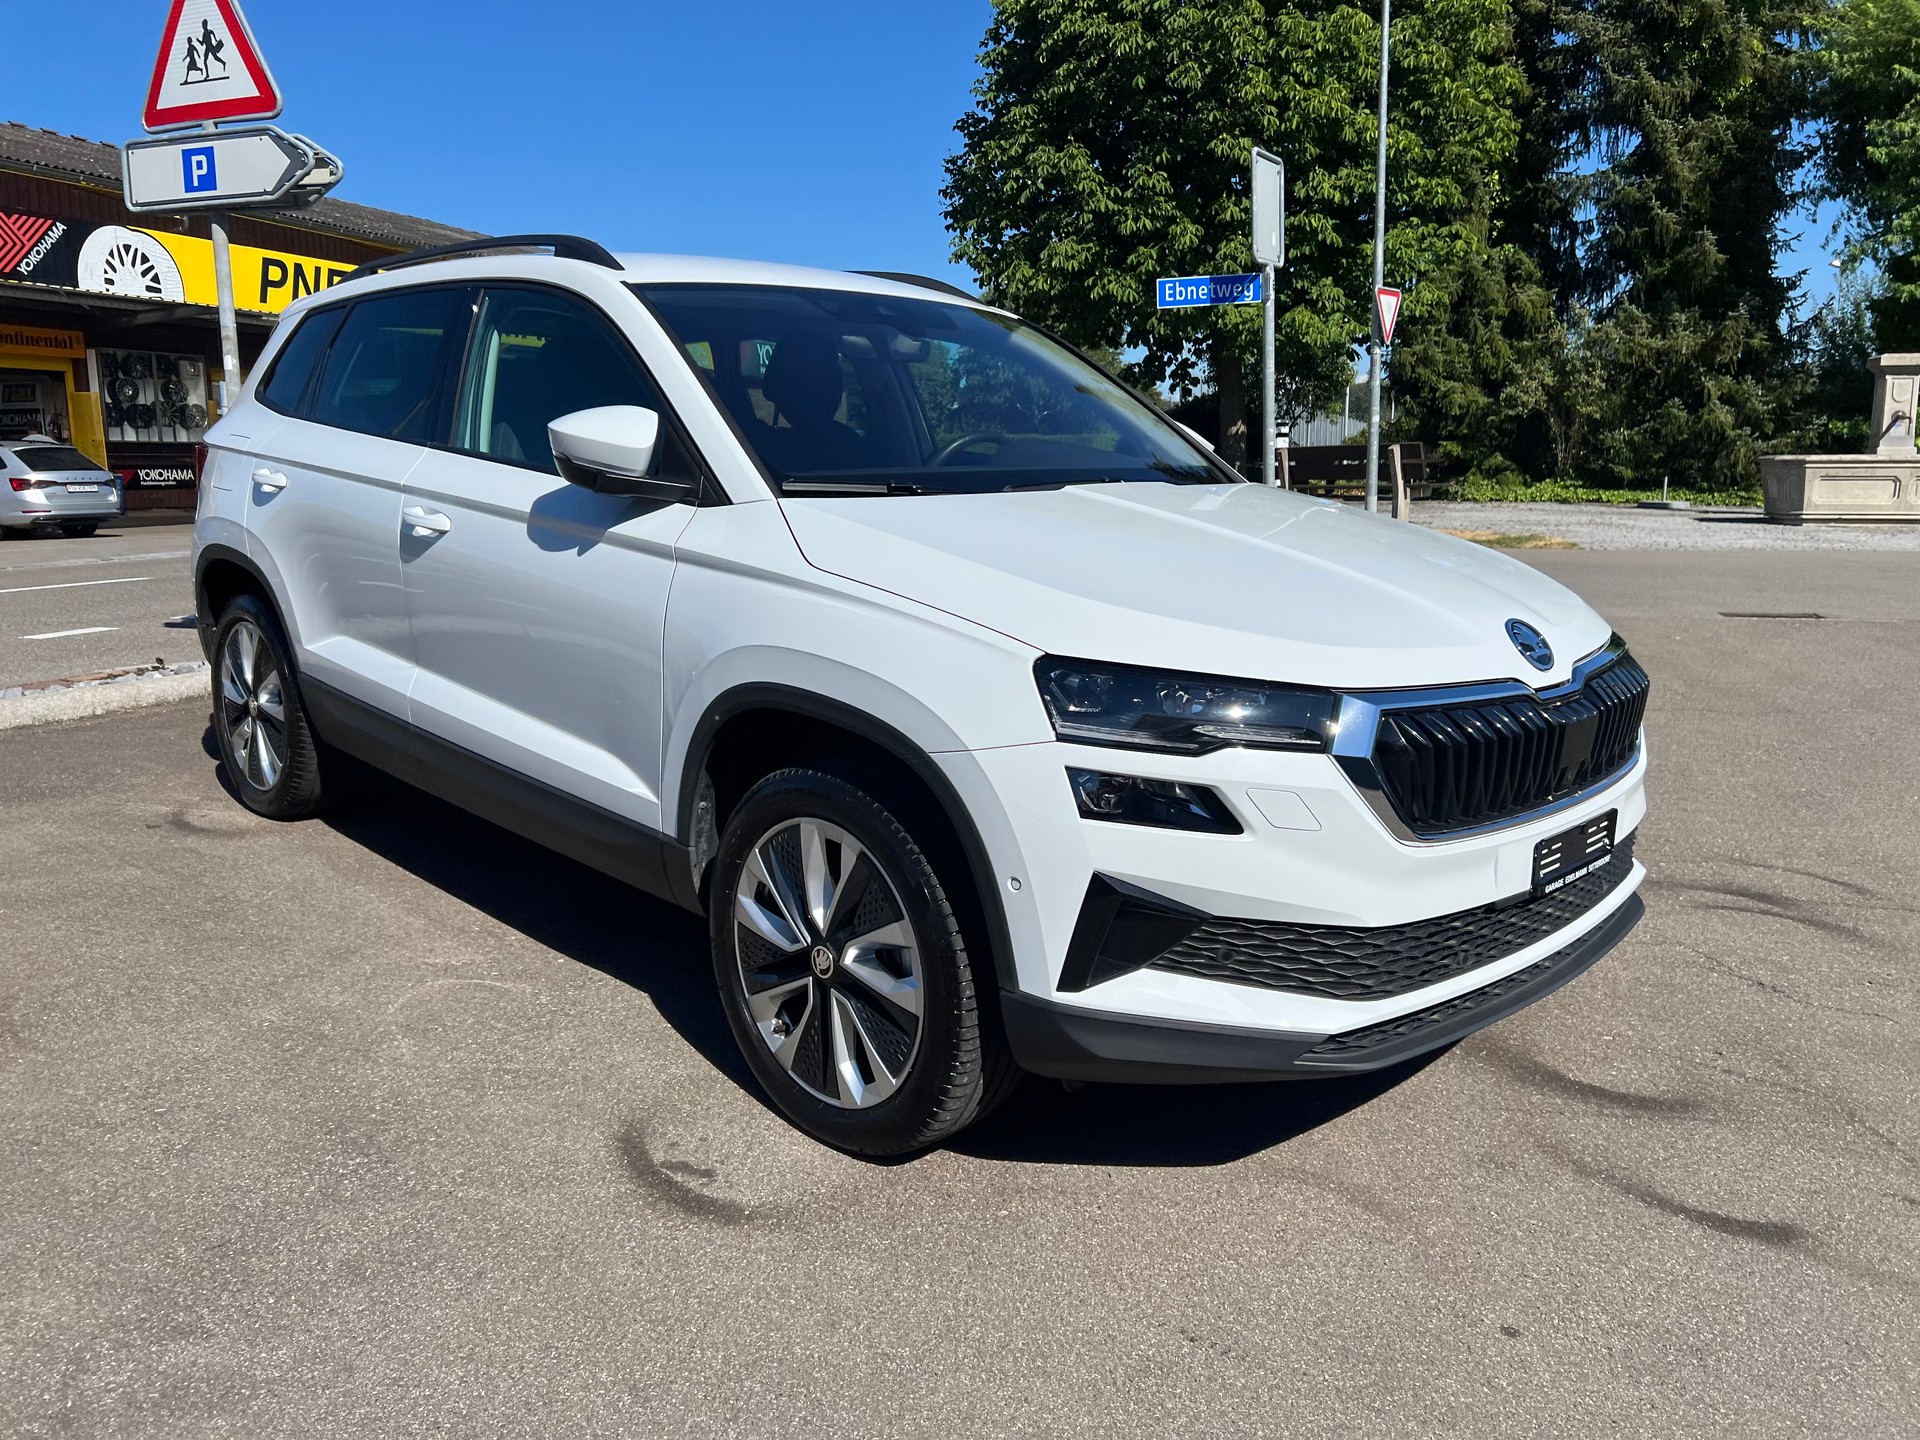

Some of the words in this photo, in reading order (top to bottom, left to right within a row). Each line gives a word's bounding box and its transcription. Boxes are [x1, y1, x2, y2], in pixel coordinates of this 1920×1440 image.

[191, 155, 208, 187] P
[17, 222, 68, 276] YOKOHAMA
[1165, 281, 1255, 301] Ebnetweg
[0, 330, 74, 349] ontinental
[137, 469, 195, 481] YOKOHAMA
[1545, 878, 1565, 893] GARAGE
[1565, 866, 1588, 883] EDELMANN
